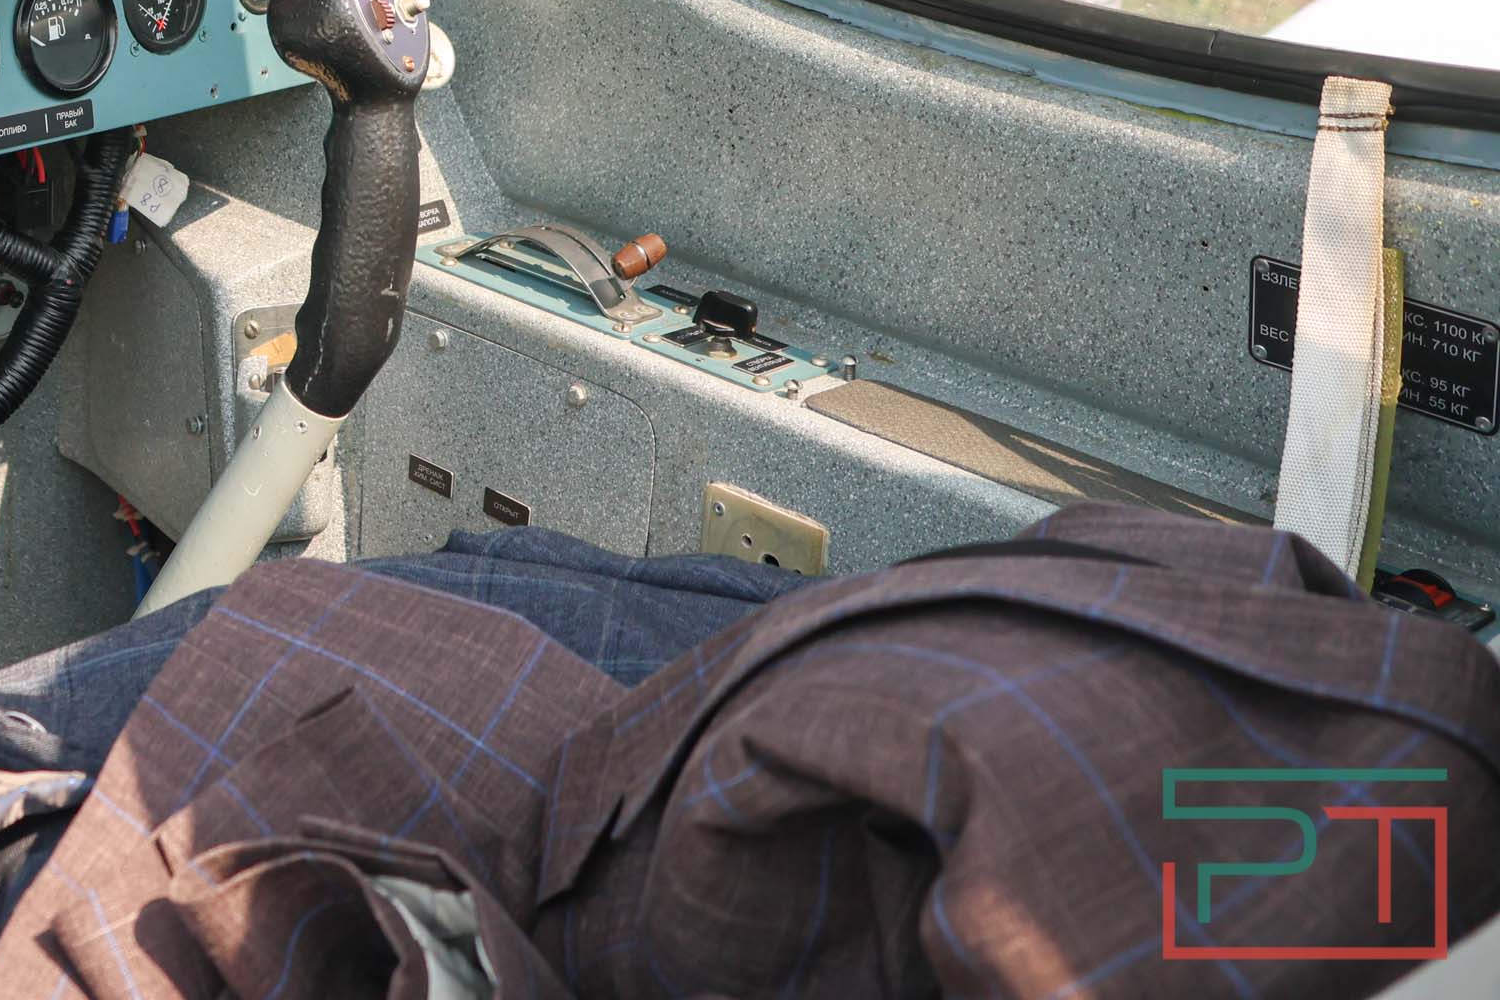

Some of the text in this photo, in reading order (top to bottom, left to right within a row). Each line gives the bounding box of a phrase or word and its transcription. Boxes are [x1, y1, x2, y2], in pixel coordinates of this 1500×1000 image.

[56, 106, 84, 122] ПРАВЫЙ
[64, 117, 78, 129] БАК
[1261, 271, 1299, 290] ВЗЛЕ
[1260, 324, 1289, 342] ВЕС
[1404, 312, 1427, 328] КС.
[1433, 320, 1467, 340] 1100
[1402, 332, 1483, 362] ИН. 710 КГ
[1402, 368, 1471, 398] КС. 95 КГ
[1428, 395, 1446, 410] 55
[1451, 402, 1469, 416] КГ
